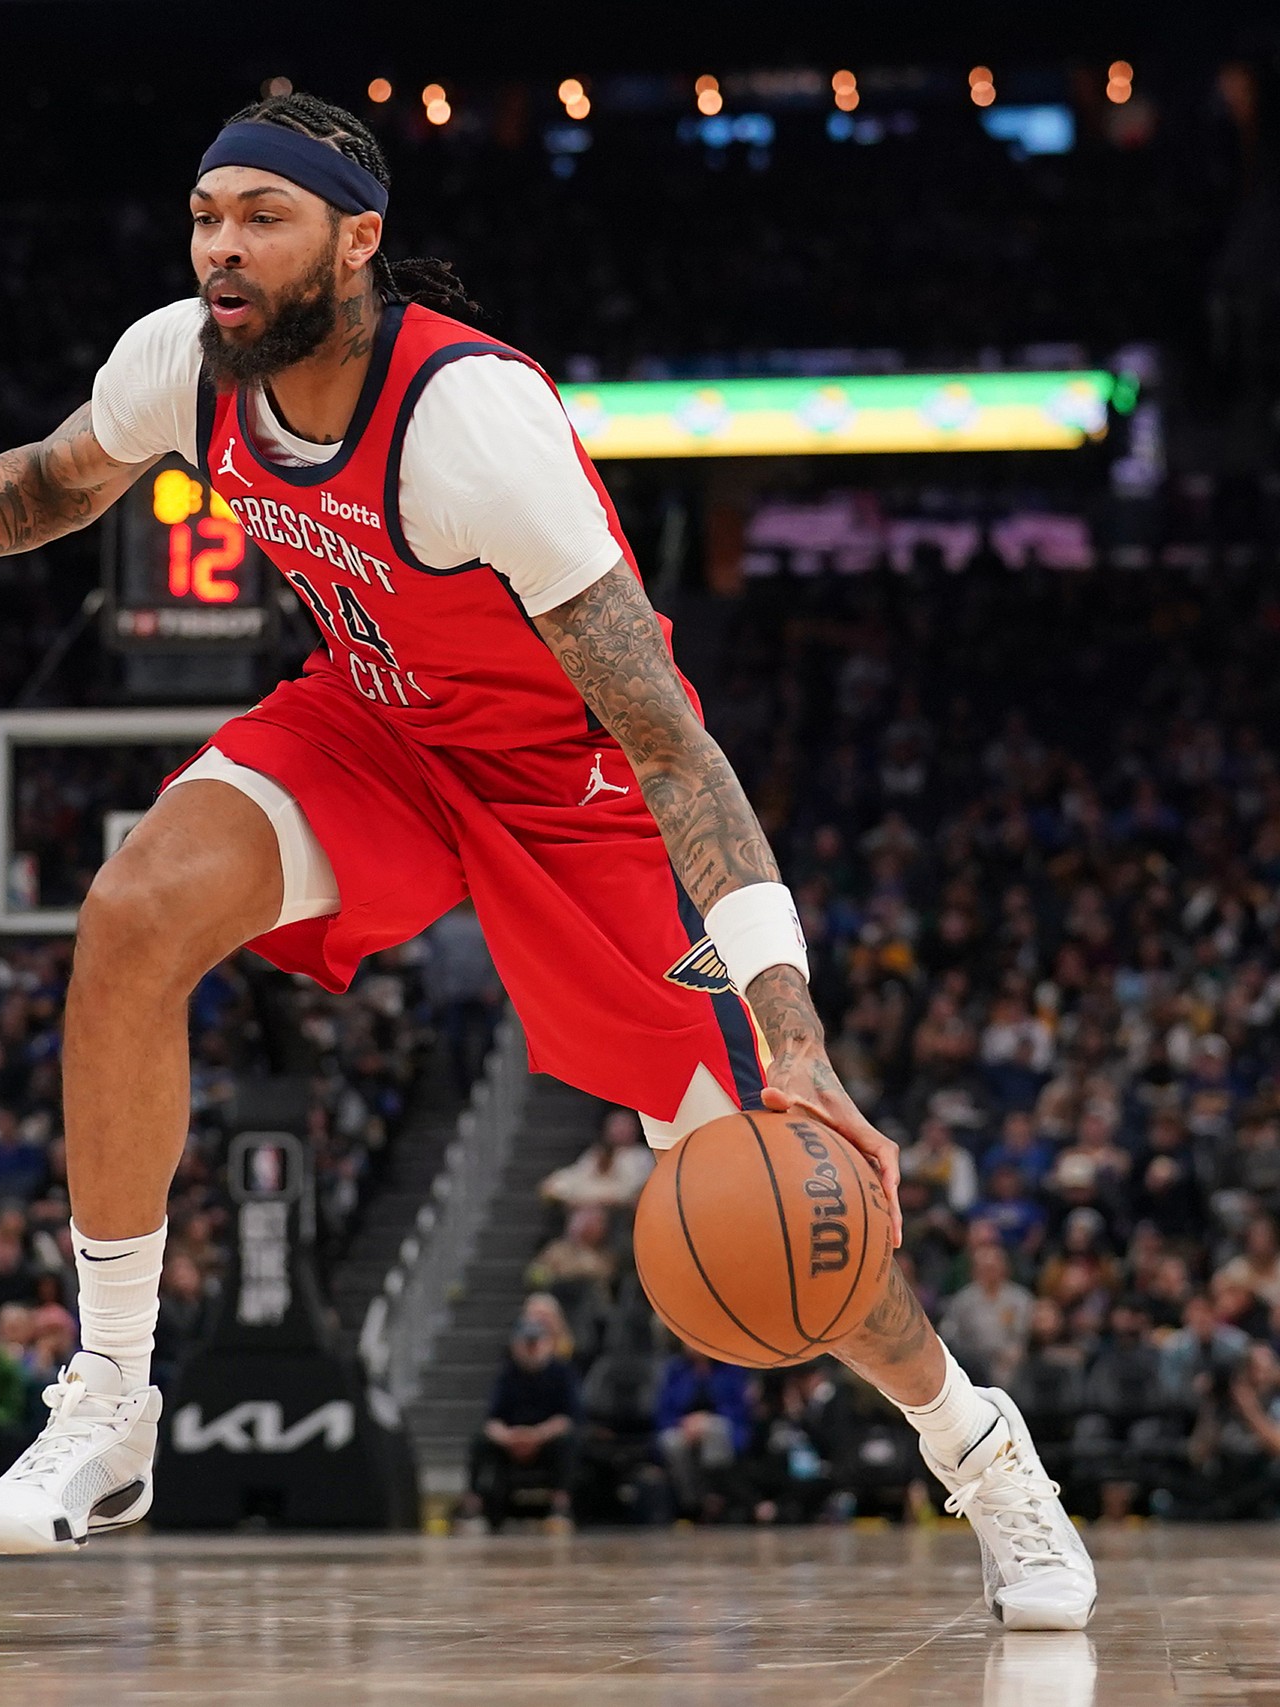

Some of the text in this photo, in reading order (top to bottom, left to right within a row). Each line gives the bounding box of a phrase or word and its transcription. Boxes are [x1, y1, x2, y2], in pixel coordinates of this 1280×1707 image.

[229, 496, 396, 595] CRESCENT
[320, 491, 382, 529] ibotta
[168, 517, 245, 603] 12
[285, 569, 401, 671] 14
[785, 1120, 849, 1279] Wilson
